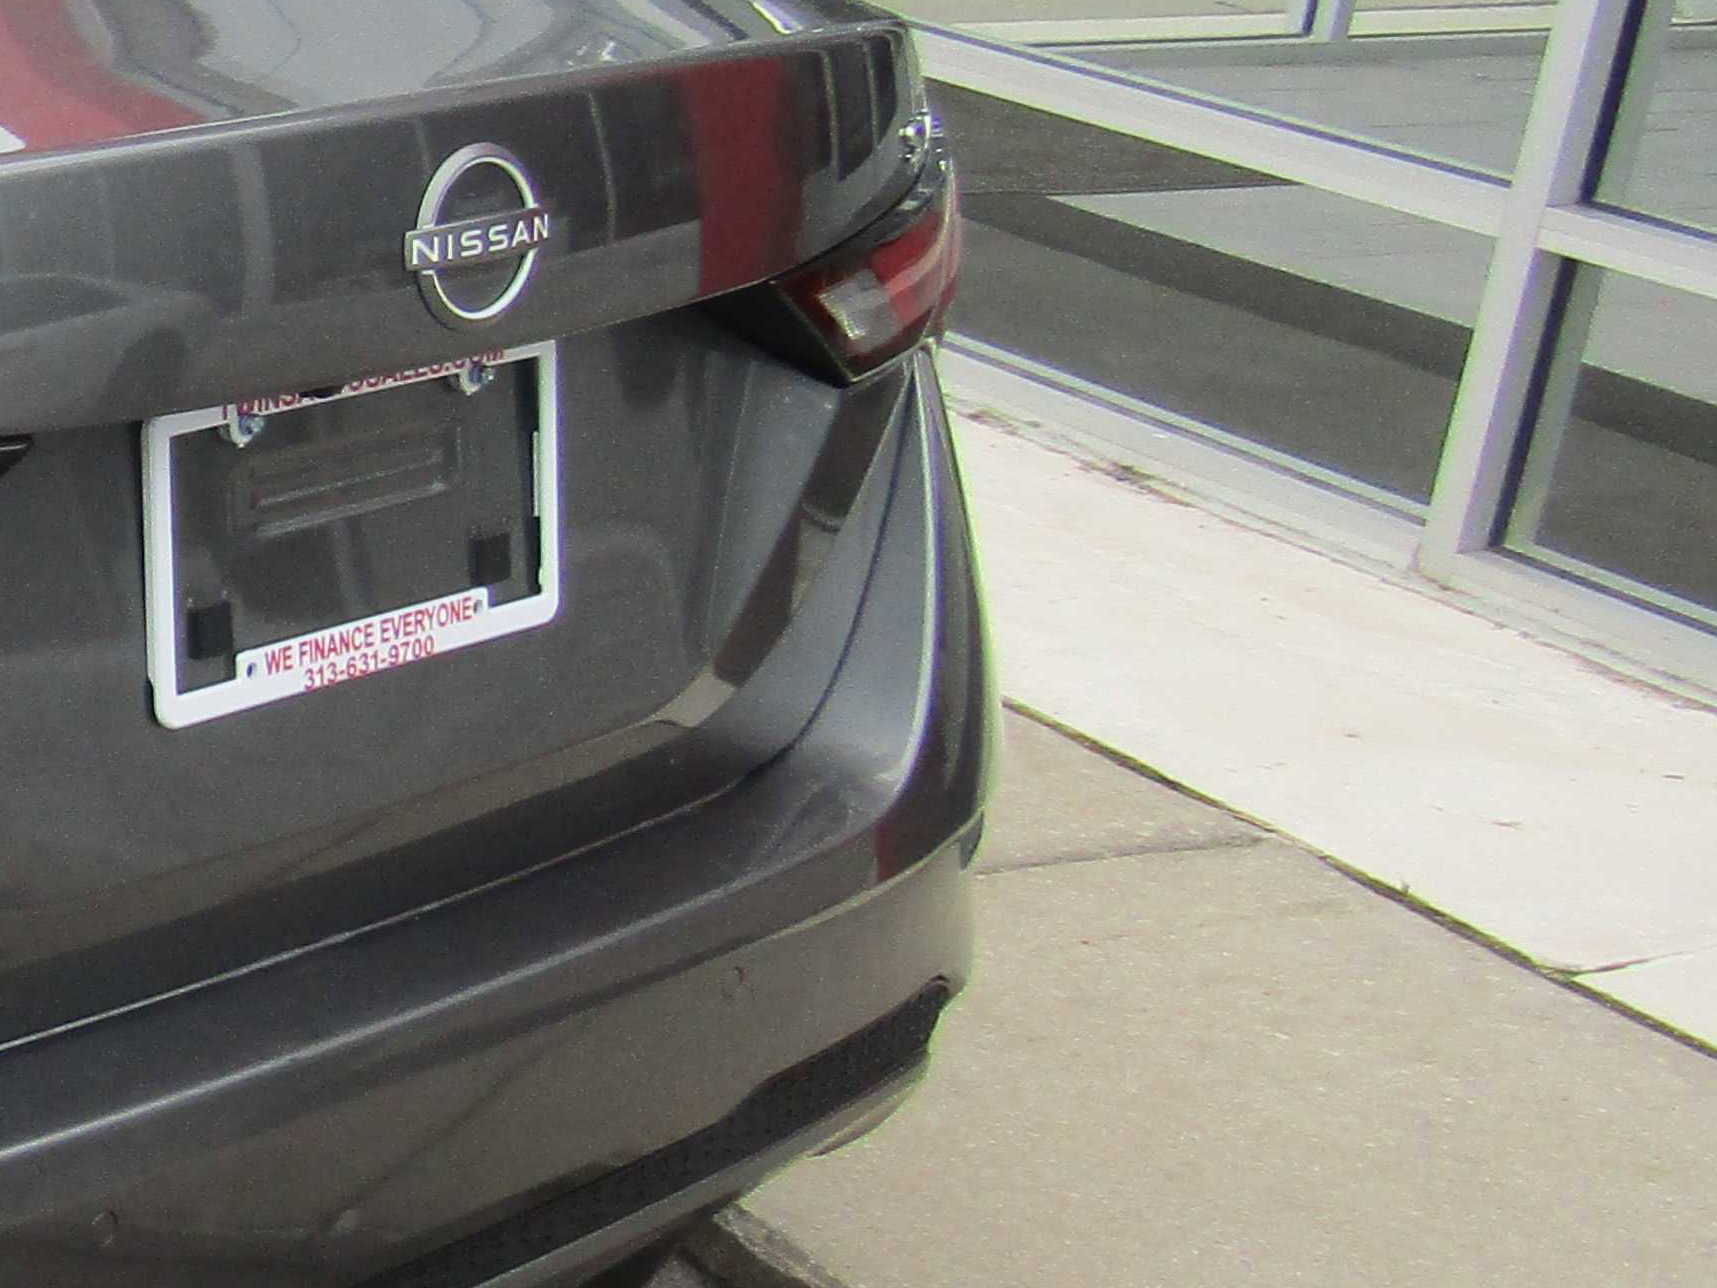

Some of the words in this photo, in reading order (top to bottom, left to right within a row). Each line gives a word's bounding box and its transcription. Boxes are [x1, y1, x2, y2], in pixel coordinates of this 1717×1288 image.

[411, 213, 550, 265] NISSAN
[266, 645, 294, 676] WE
[299, 622, 375, 667] FINANCE
[380, 596, 473, 643] EVERYONE
[304, 634, 436, 692] 313-631-9700
